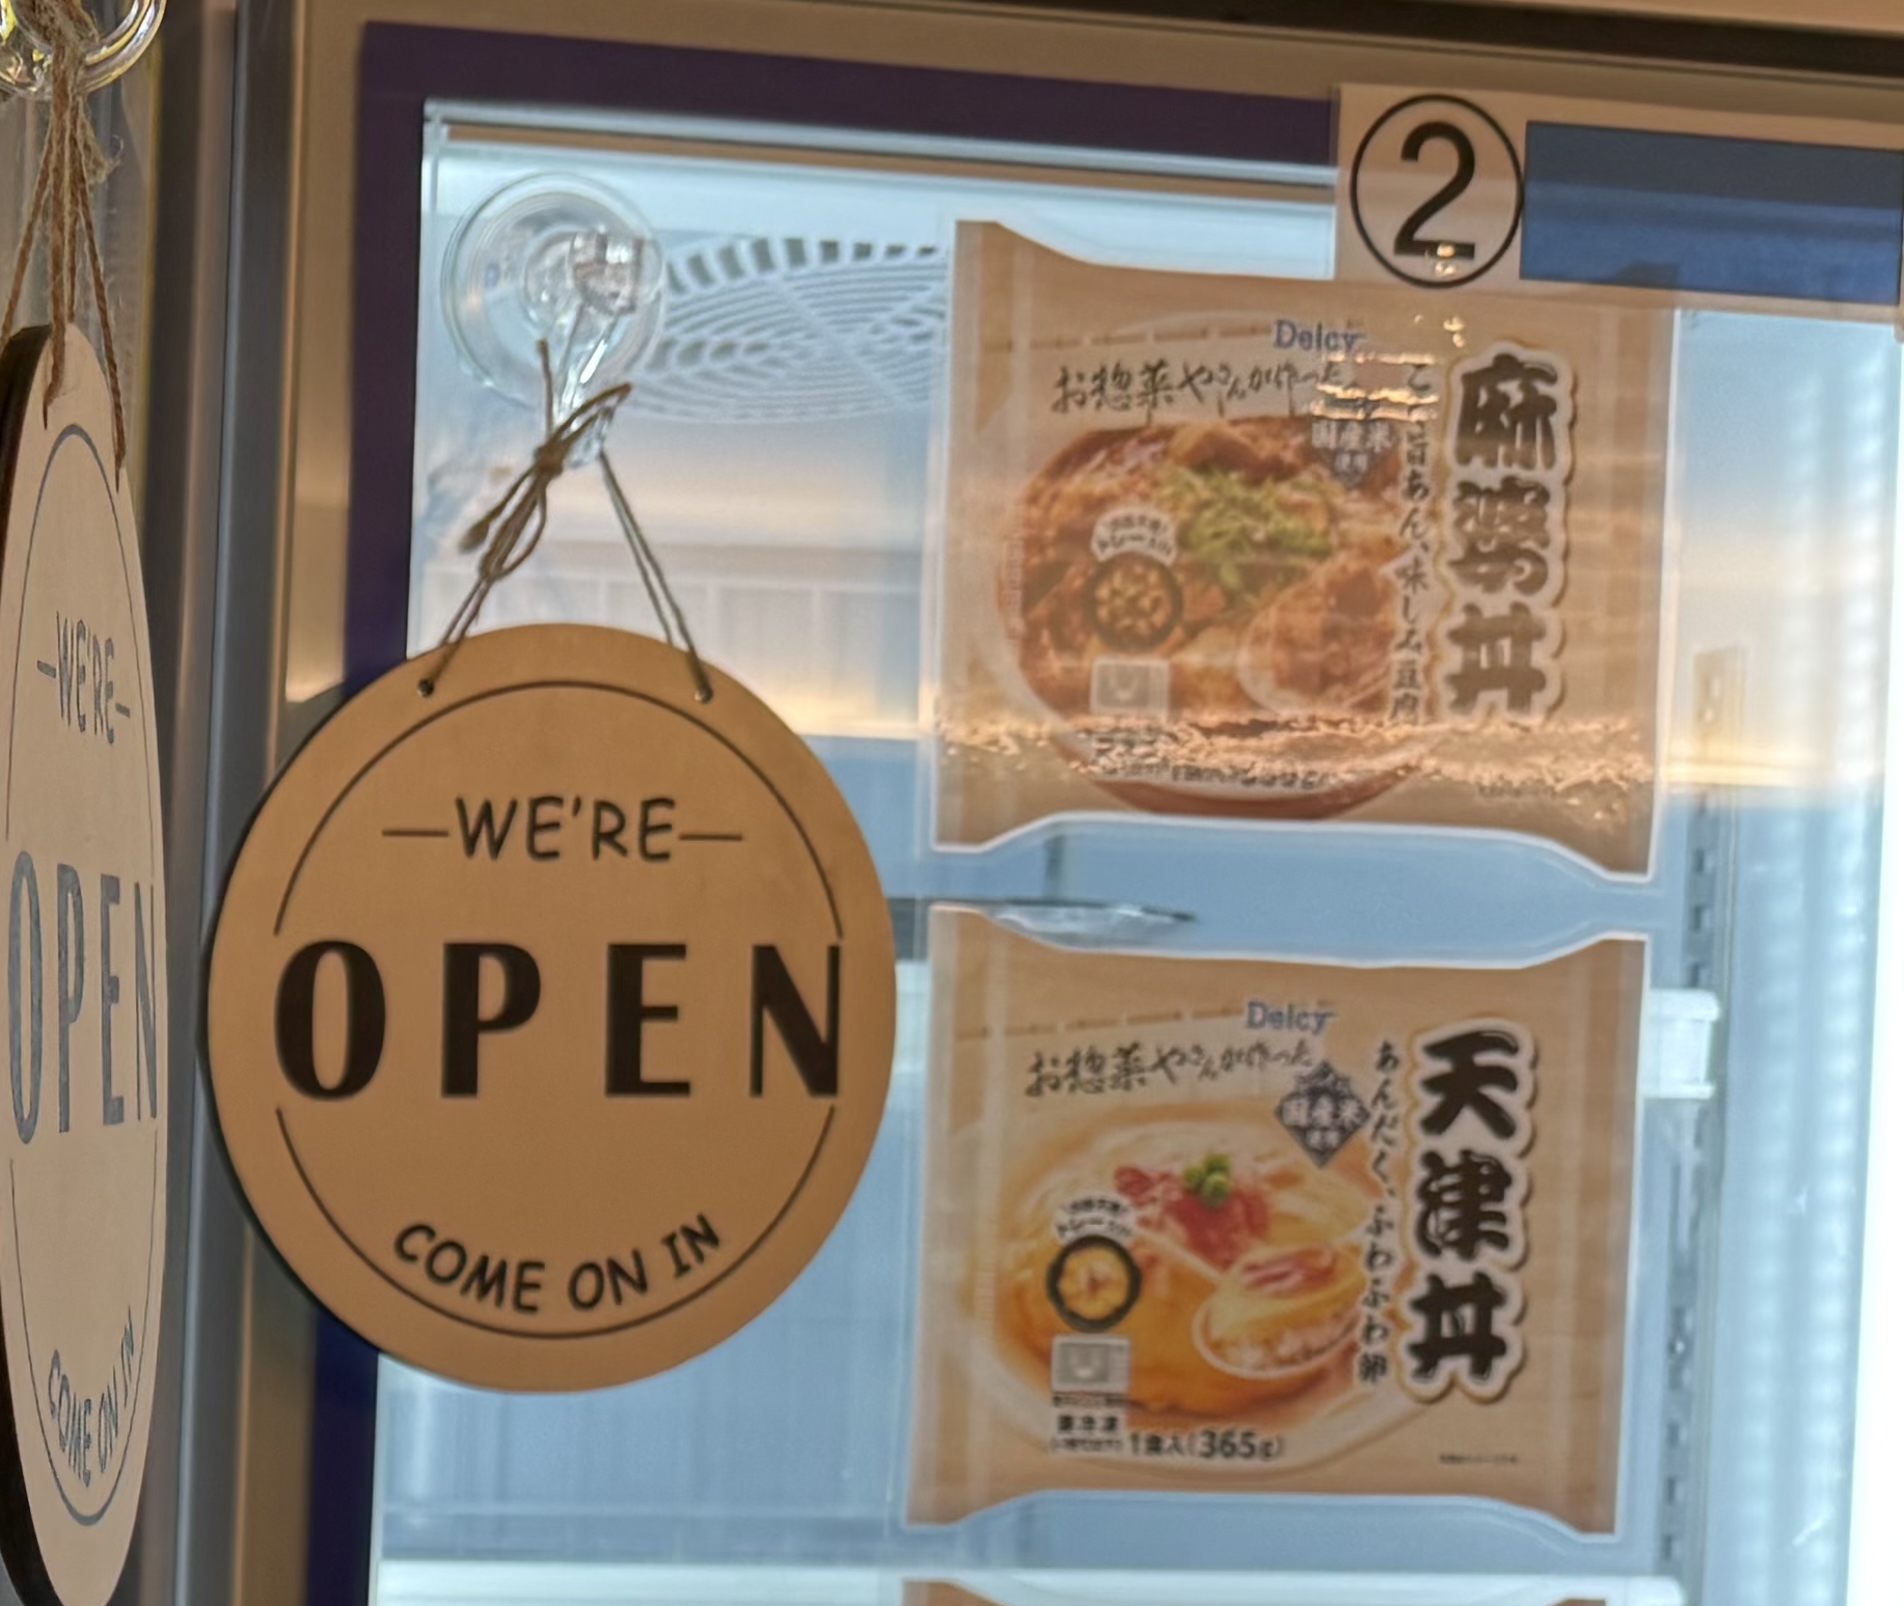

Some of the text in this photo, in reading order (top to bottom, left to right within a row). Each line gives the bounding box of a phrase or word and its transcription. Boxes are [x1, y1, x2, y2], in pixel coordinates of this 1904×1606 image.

[1275, 319, 1364, 353] Delcy
[56, 611, 115, 746] WE'RE
[454, 794, 677, 862] WE'RE
[8, 850, 158, 1145] OPEN
[274, 939, 843, 1101] OPEN
[1246, 1000, 1333, 1034] Delcy
[394, 1212, 721, 1315] COME ON IN
[1407, 1029, 1519, 1381] 天津丼
[48, 1349, 93, 1488] COME
[98, 1366, 119, 1475] ON
